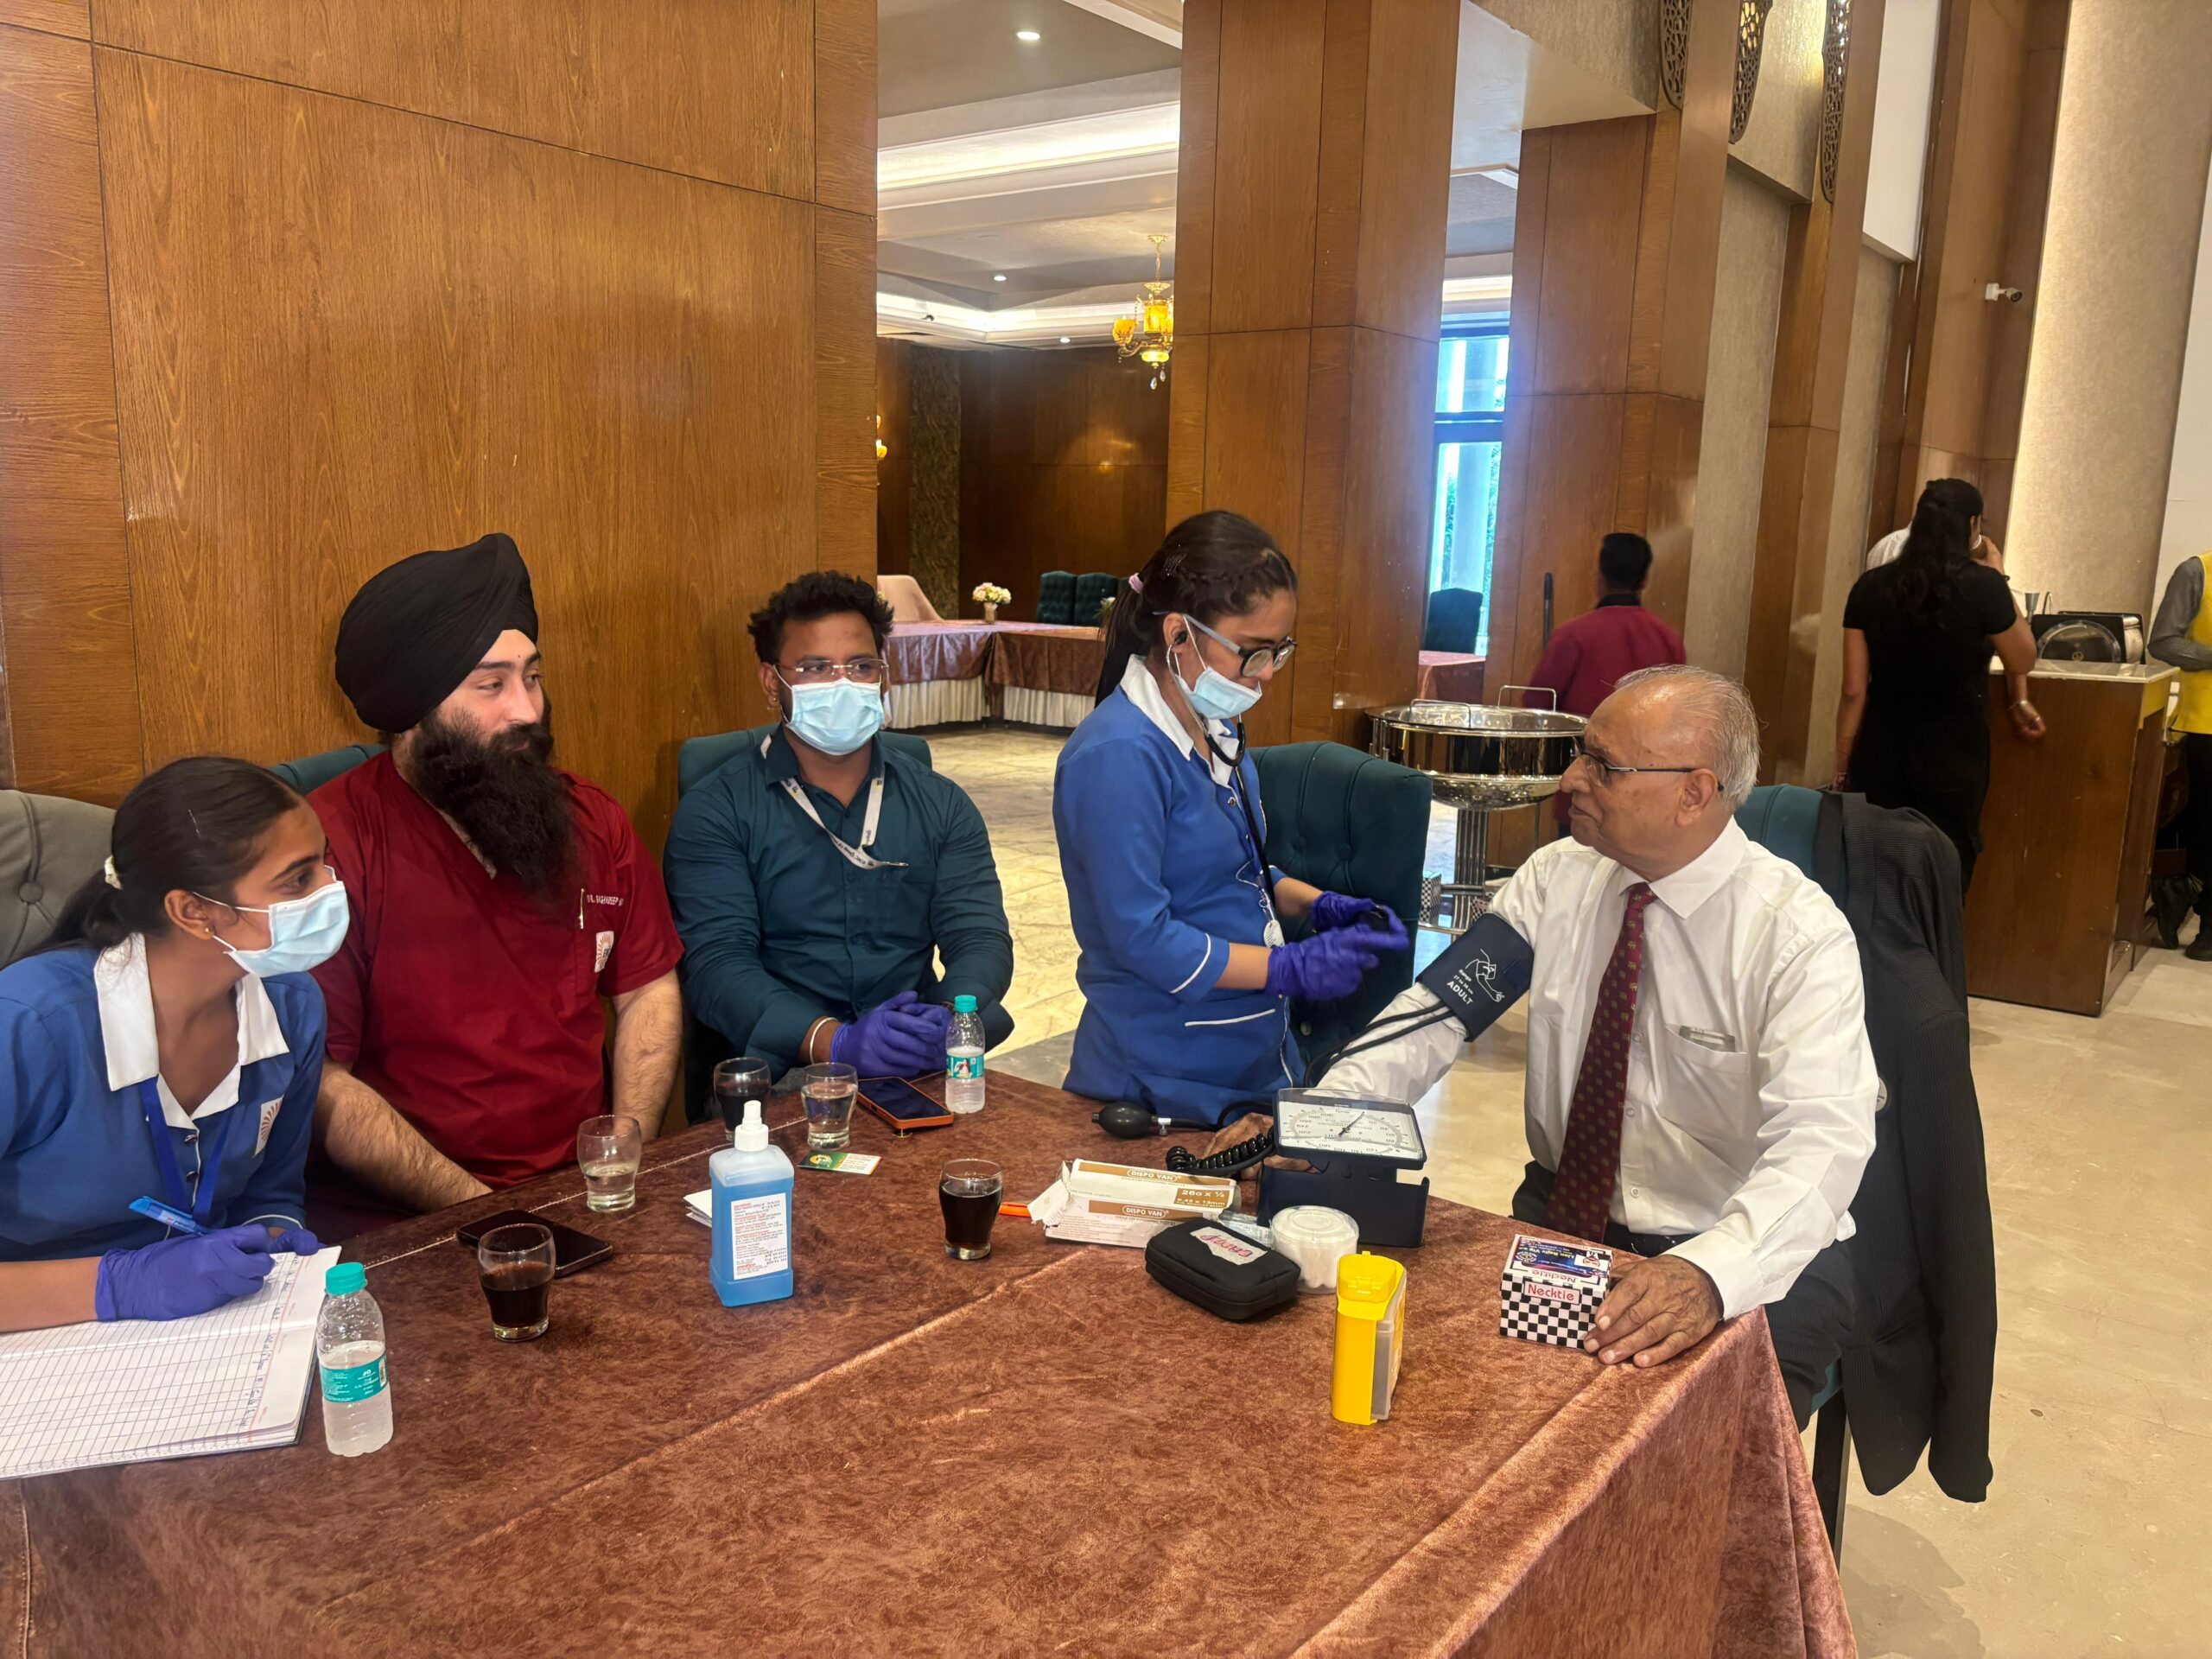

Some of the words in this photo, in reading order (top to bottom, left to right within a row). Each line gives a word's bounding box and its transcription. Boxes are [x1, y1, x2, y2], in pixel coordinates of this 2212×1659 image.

[1446, 981, 1473, 1005] ADULT
[1532, 1269, 1576, 1283] Necktie
[1528, 1283, 1574, 1301] Necktie
